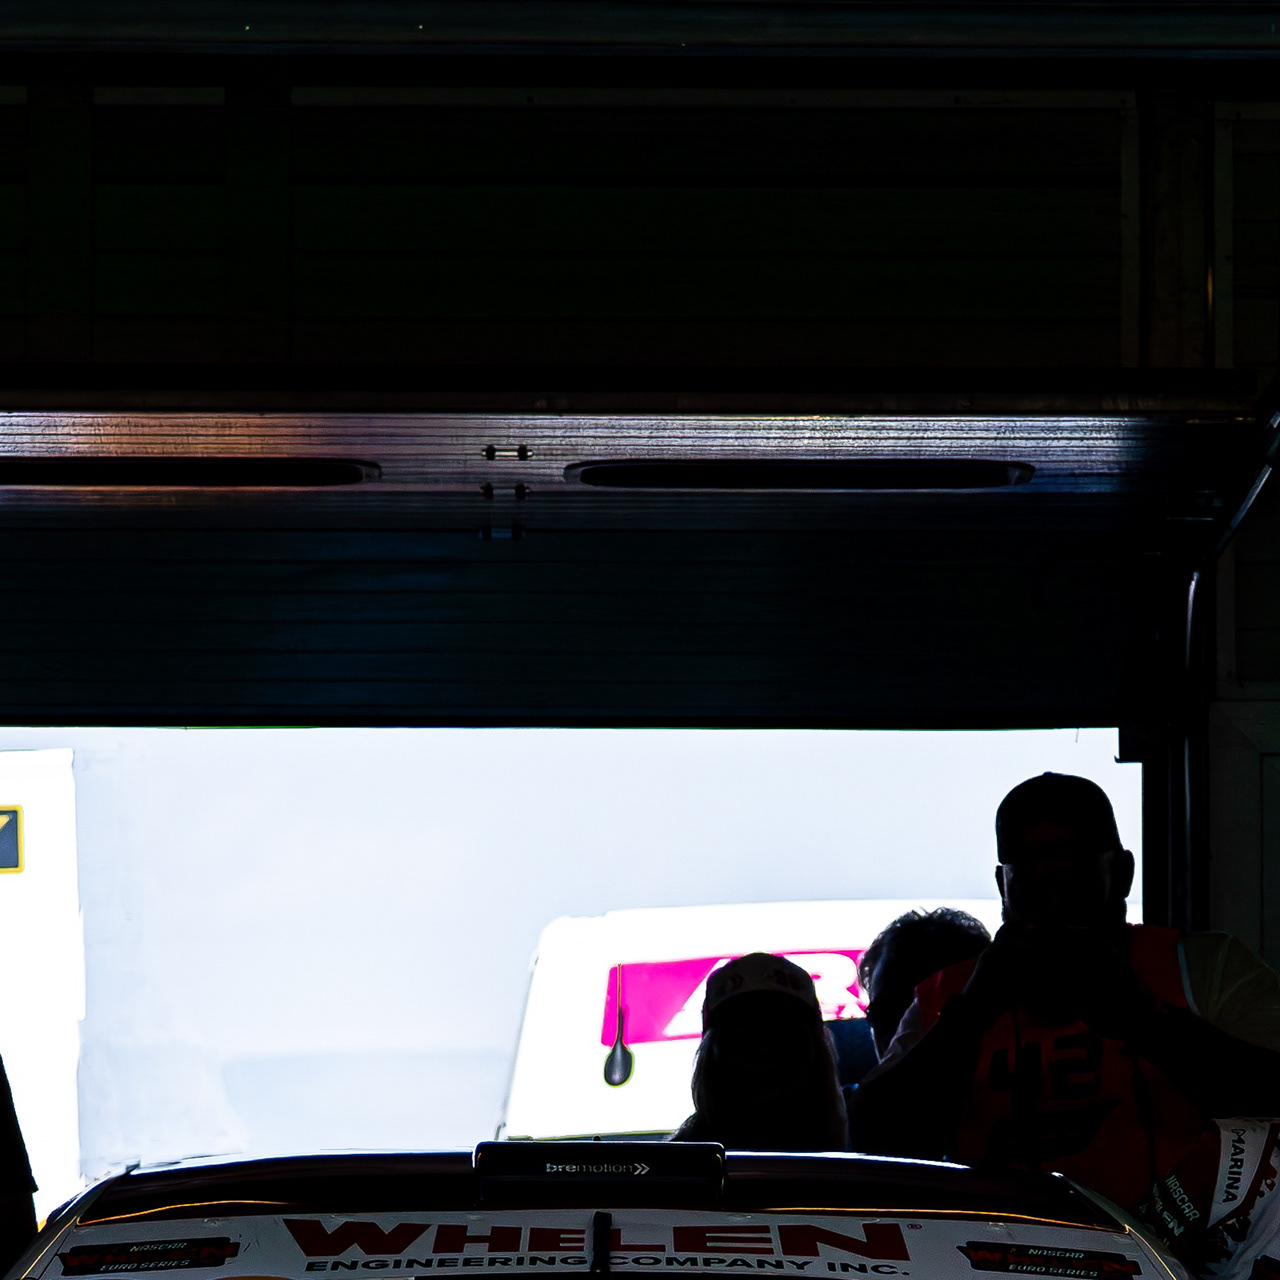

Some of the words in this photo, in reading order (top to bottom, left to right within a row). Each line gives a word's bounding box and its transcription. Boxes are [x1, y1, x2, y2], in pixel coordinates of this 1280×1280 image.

[545, 1162, 635, 1175] bremotion
[1222, 1128, 1246, 1204] MARINA
[1165, 1174, 1202, 1222] NASCAR
[282, 1217, 910, 1261] WHELEN
[129, 1242, 188, 1253] NASCAR
[1027, 1247, 1085, 1259] NASCAR
[99, 1262, 138, 1272] EURO
[139, 1259, 192, 1269] SERIES
[304, 1255, 588, 1272] ENGINEERING
[605, 1255, 822, 1272] COMPANY
[827, 1261, 911, 1277] INC.
[1008, 1263, 1046, 1273] EURO
[1048, 1267, 1099, 1278] SERIES
